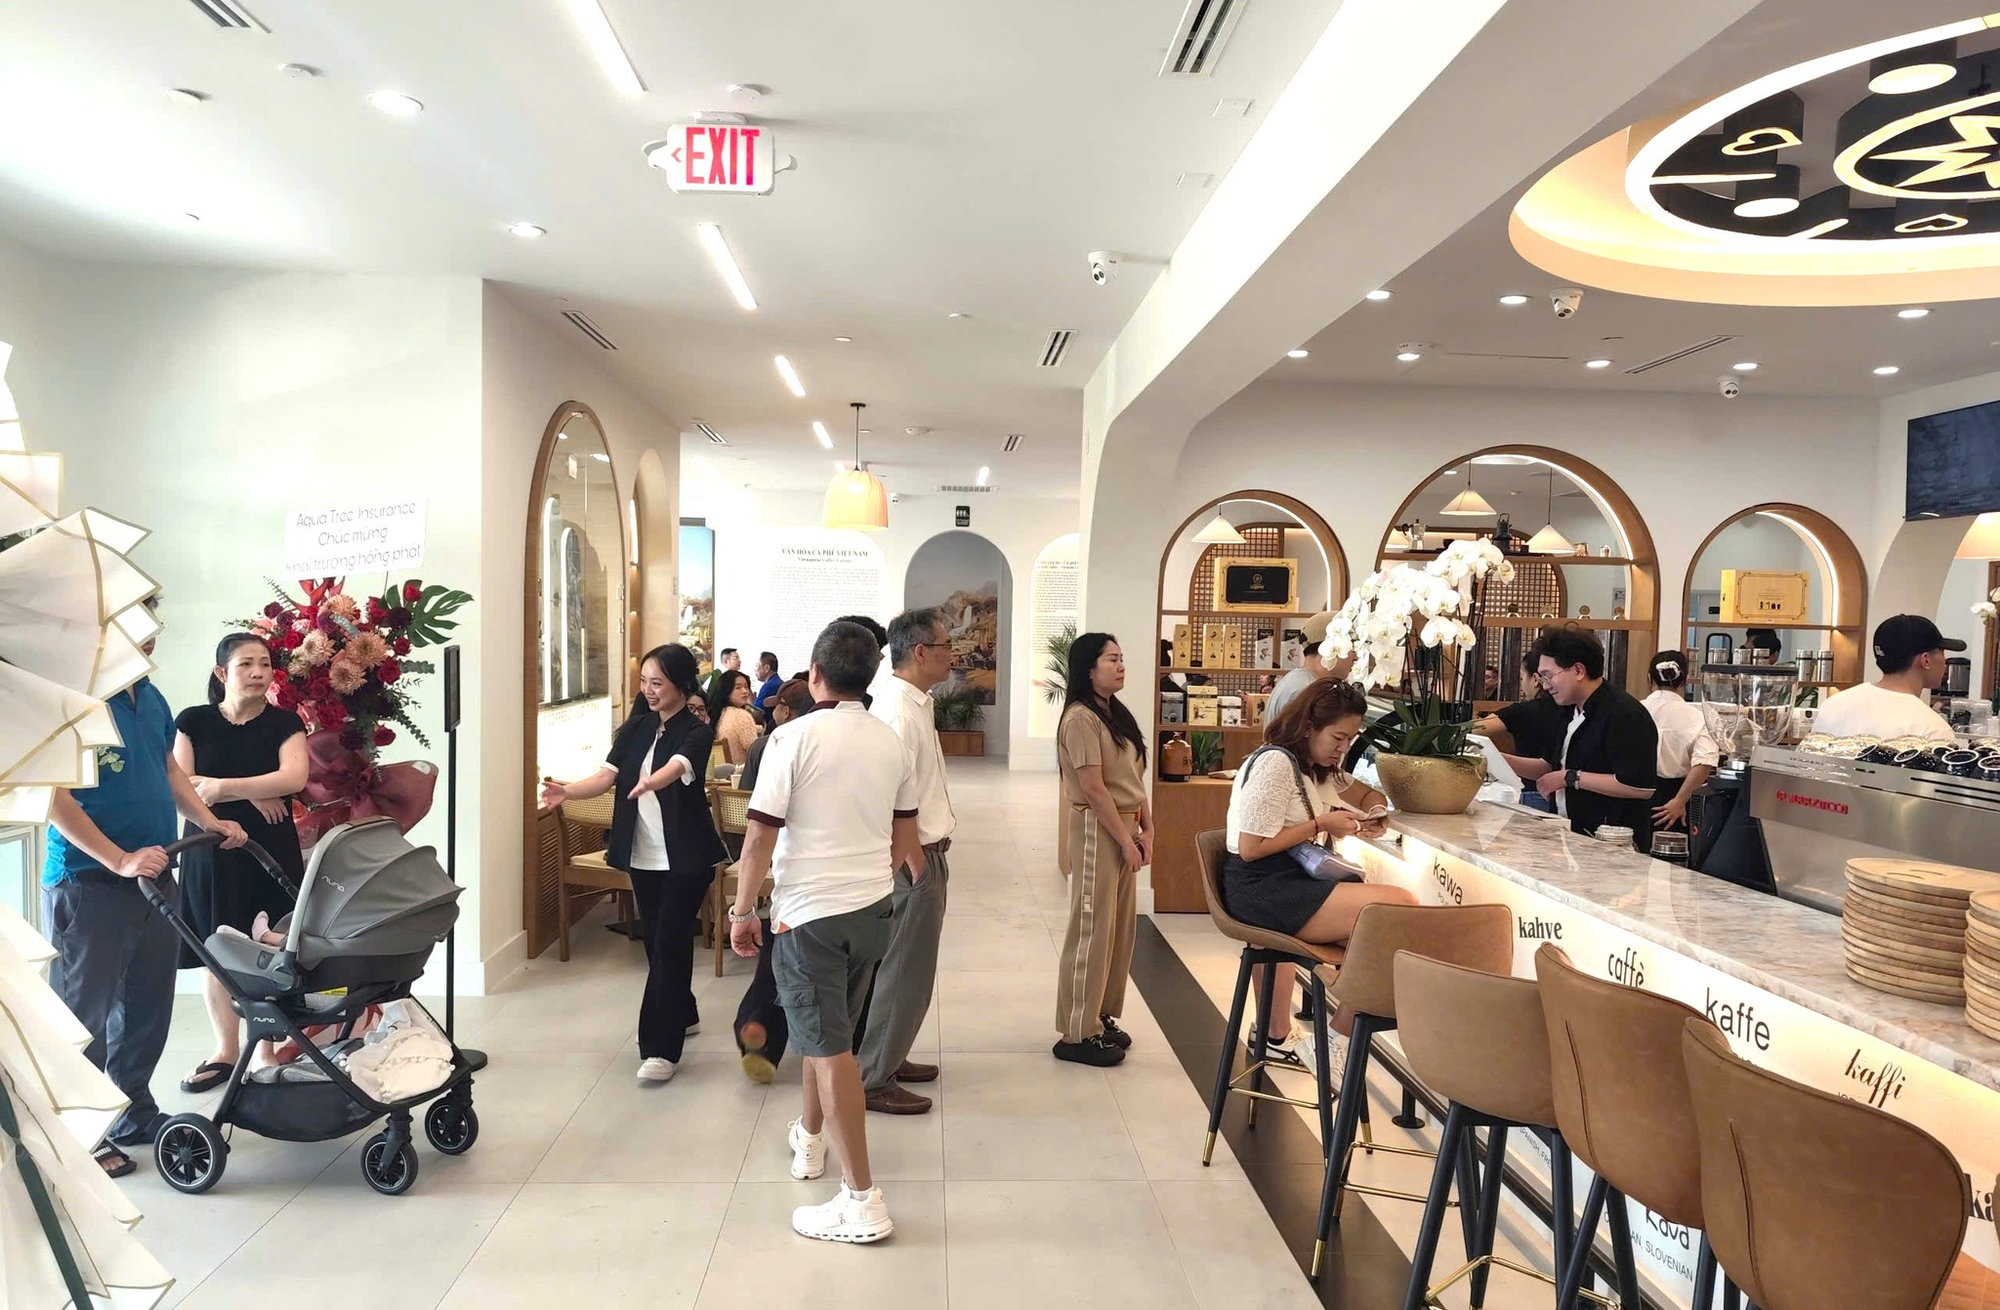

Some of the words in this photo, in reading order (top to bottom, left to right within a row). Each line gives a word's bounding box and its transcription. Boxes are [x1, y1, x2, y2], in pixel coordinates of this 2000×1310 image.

[686, 127, 760, 185] EXIT
[297, 513, 327, 528] Aqua
[330, 509, 354, 523] Tree
[358, 502, 416, 519] Insurance
[318, 529, 350, 546] Chúc
[321, 875, 345, 892] nuna
[1432, 854, 1463, 905] kawa
[1518, 916, 1563, 940] kahve
[1608, 947, 1645, 988] caffè
[1706, 987, 1771, 1051] kaffe
[1844, 1048, 1906, 1109] kaffi
[1963, 1172, 1995, 1223] ka
[1645, 1207, 1690, 1251] kava
[1645, 1240, 1694, 1283] SLOVENIAN
